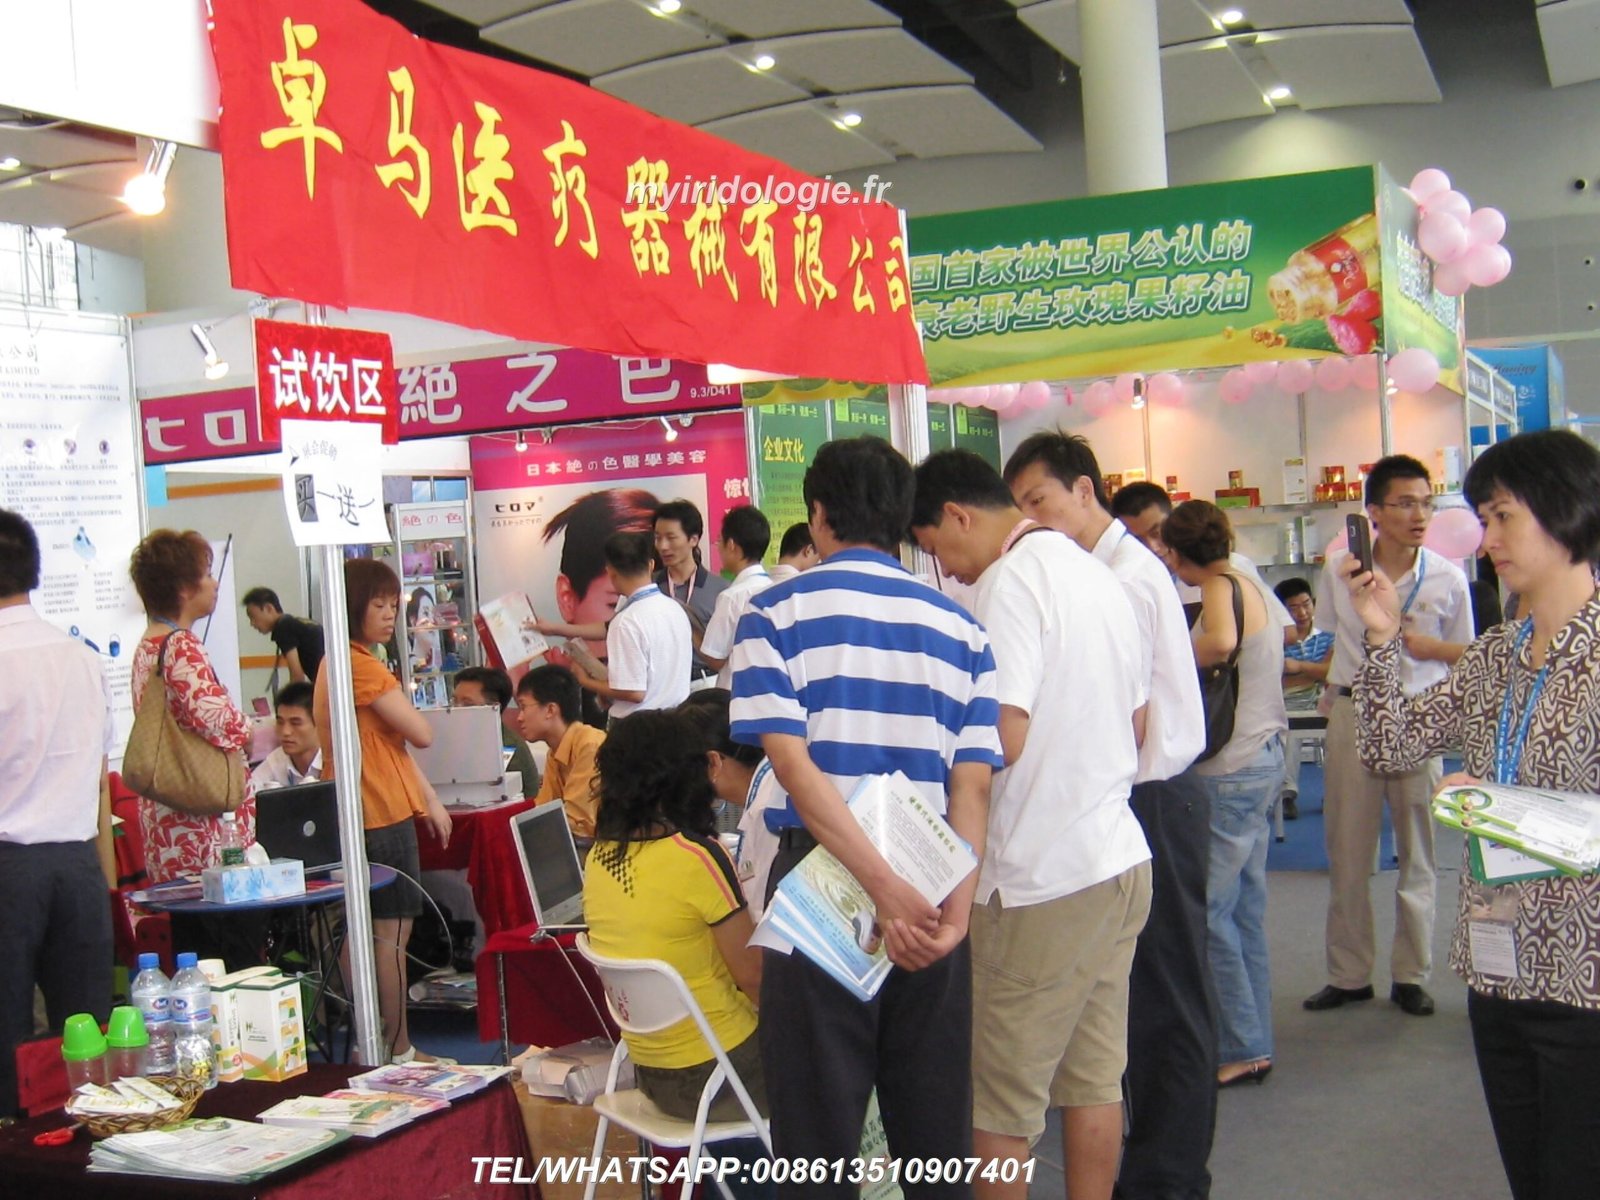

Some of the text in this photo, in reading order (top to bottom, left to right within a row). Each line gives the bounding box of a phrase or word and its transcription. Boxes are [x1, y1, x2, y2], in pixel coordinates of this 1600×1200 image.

[268, 346, 387, 415] 试饮区
[689, 384, 732, 399] 9.3/D41
[763, 435, 805, 464] 企业文化
[296, 474, 375, 526] 买一送一
